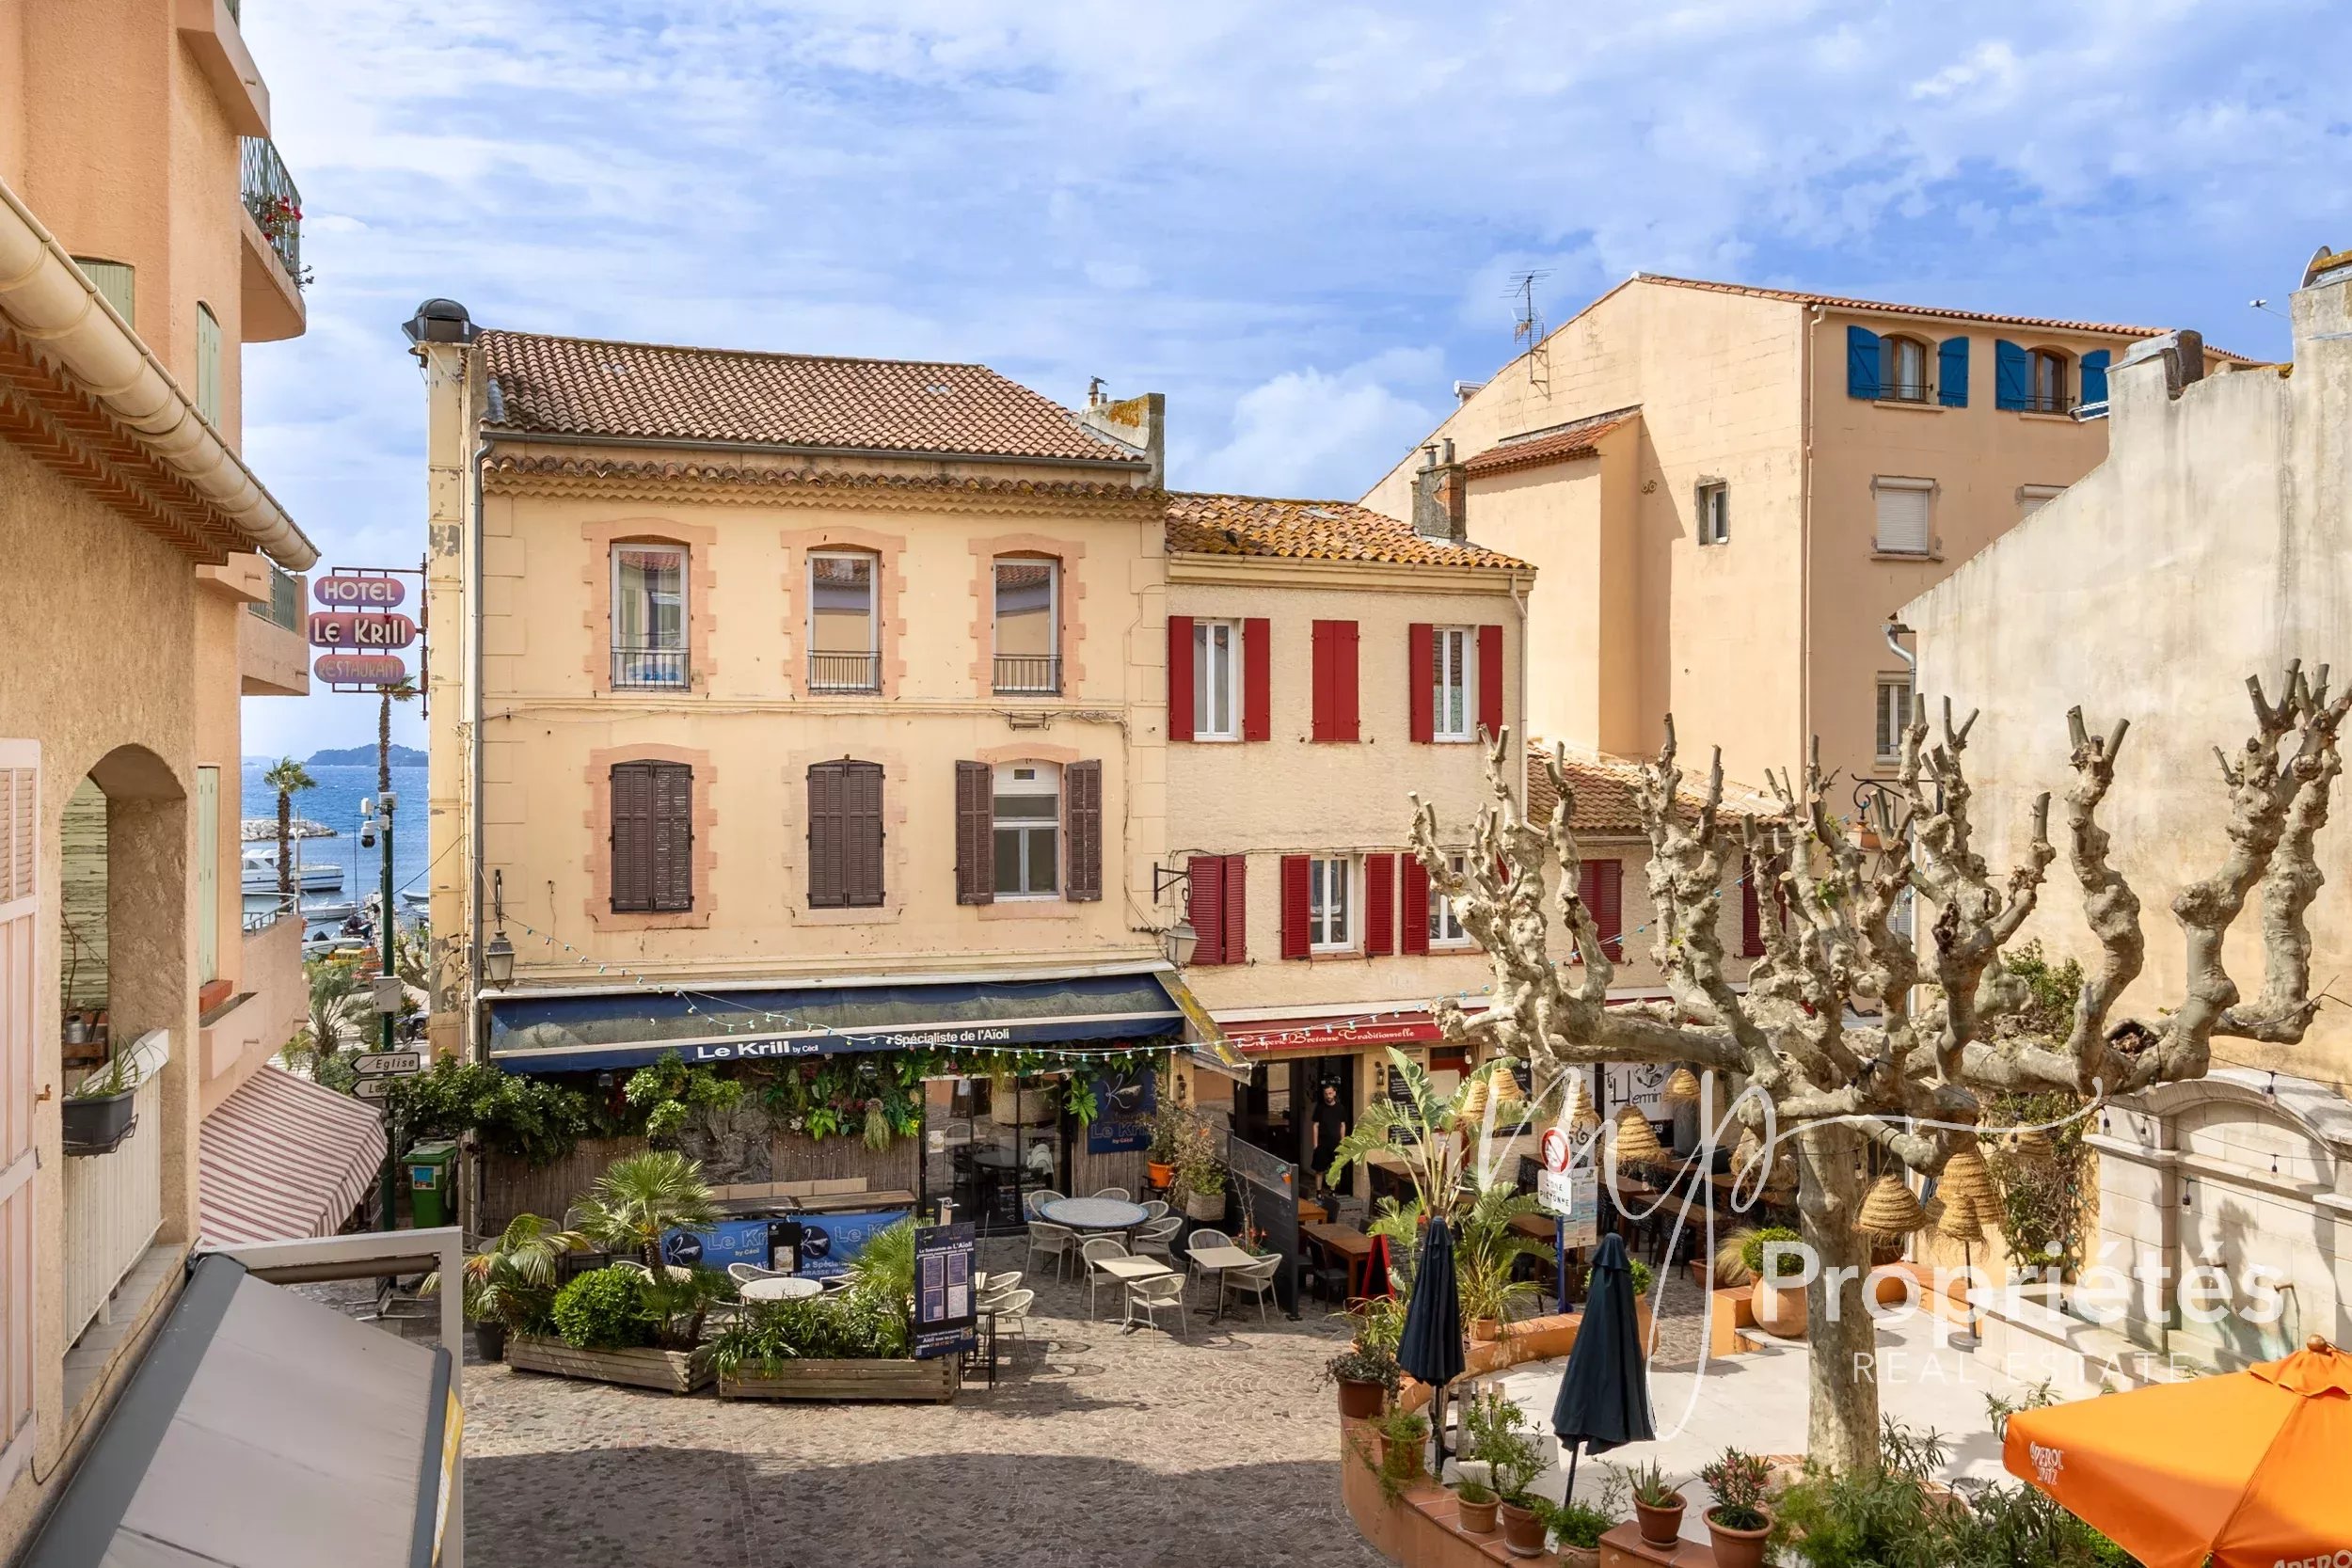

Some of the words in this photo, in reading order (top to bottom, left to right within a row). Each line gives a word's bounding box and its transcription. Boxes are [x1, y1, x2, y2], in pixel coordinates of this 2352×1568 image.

[324, 580, 396, 601] HOTEL
[319, 660, 400, 678] RESTAURANT
[894, 1031, 958, 1047] Spécialiste
[960, 1030, 975, 1041] de
[977, 1028, 1009, 1040] l'Aïoli
[1289, 1033, 1339, 1044] Bretonne
[1339, 1027, 1415, 1041] Traditionnelle
[697, 1046, 731, 1059] Le
[737, 1040, 790, 1055] Krill
[792, 1046, 802, 1054] by
[375, 1057, 415, 1071] Eglise
[1119, 1121, 1148, 1137] Kri
[707, 1233, 735, 1251] Le
[741, 1228, 768, 1248] Kr
[834, 1226, 862, 1243] Le
